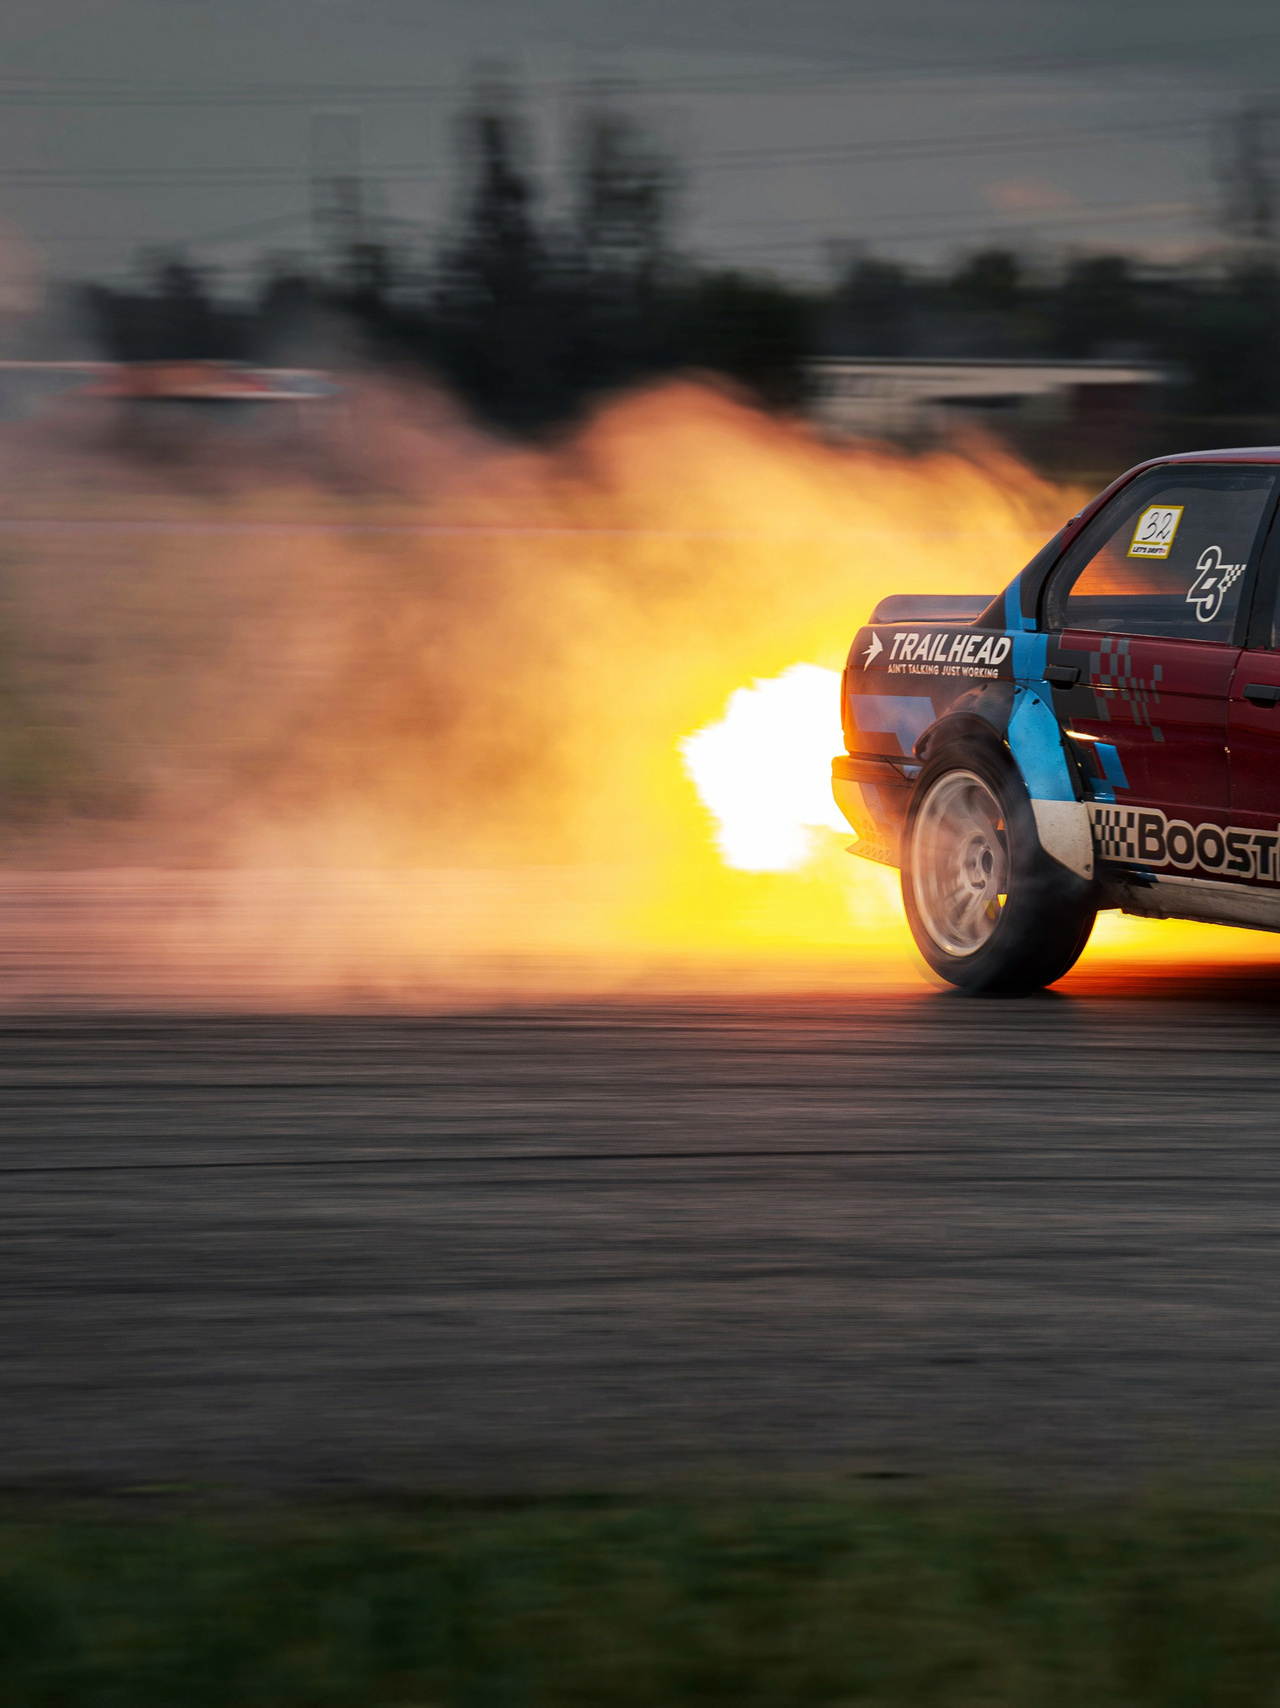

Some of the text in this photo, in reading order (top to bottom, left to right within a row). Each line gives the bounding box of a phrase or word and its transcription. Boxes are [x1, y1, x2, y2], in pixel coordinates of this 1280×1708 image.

[1141, 511, 1173, 541] 32
[889, 632, 1012, 665] TRAILHEAD
[908, 663, 940, 675] TALKING
[941, 665, 961, 676] JUST
[961, 666, 999, 679] WORKING
